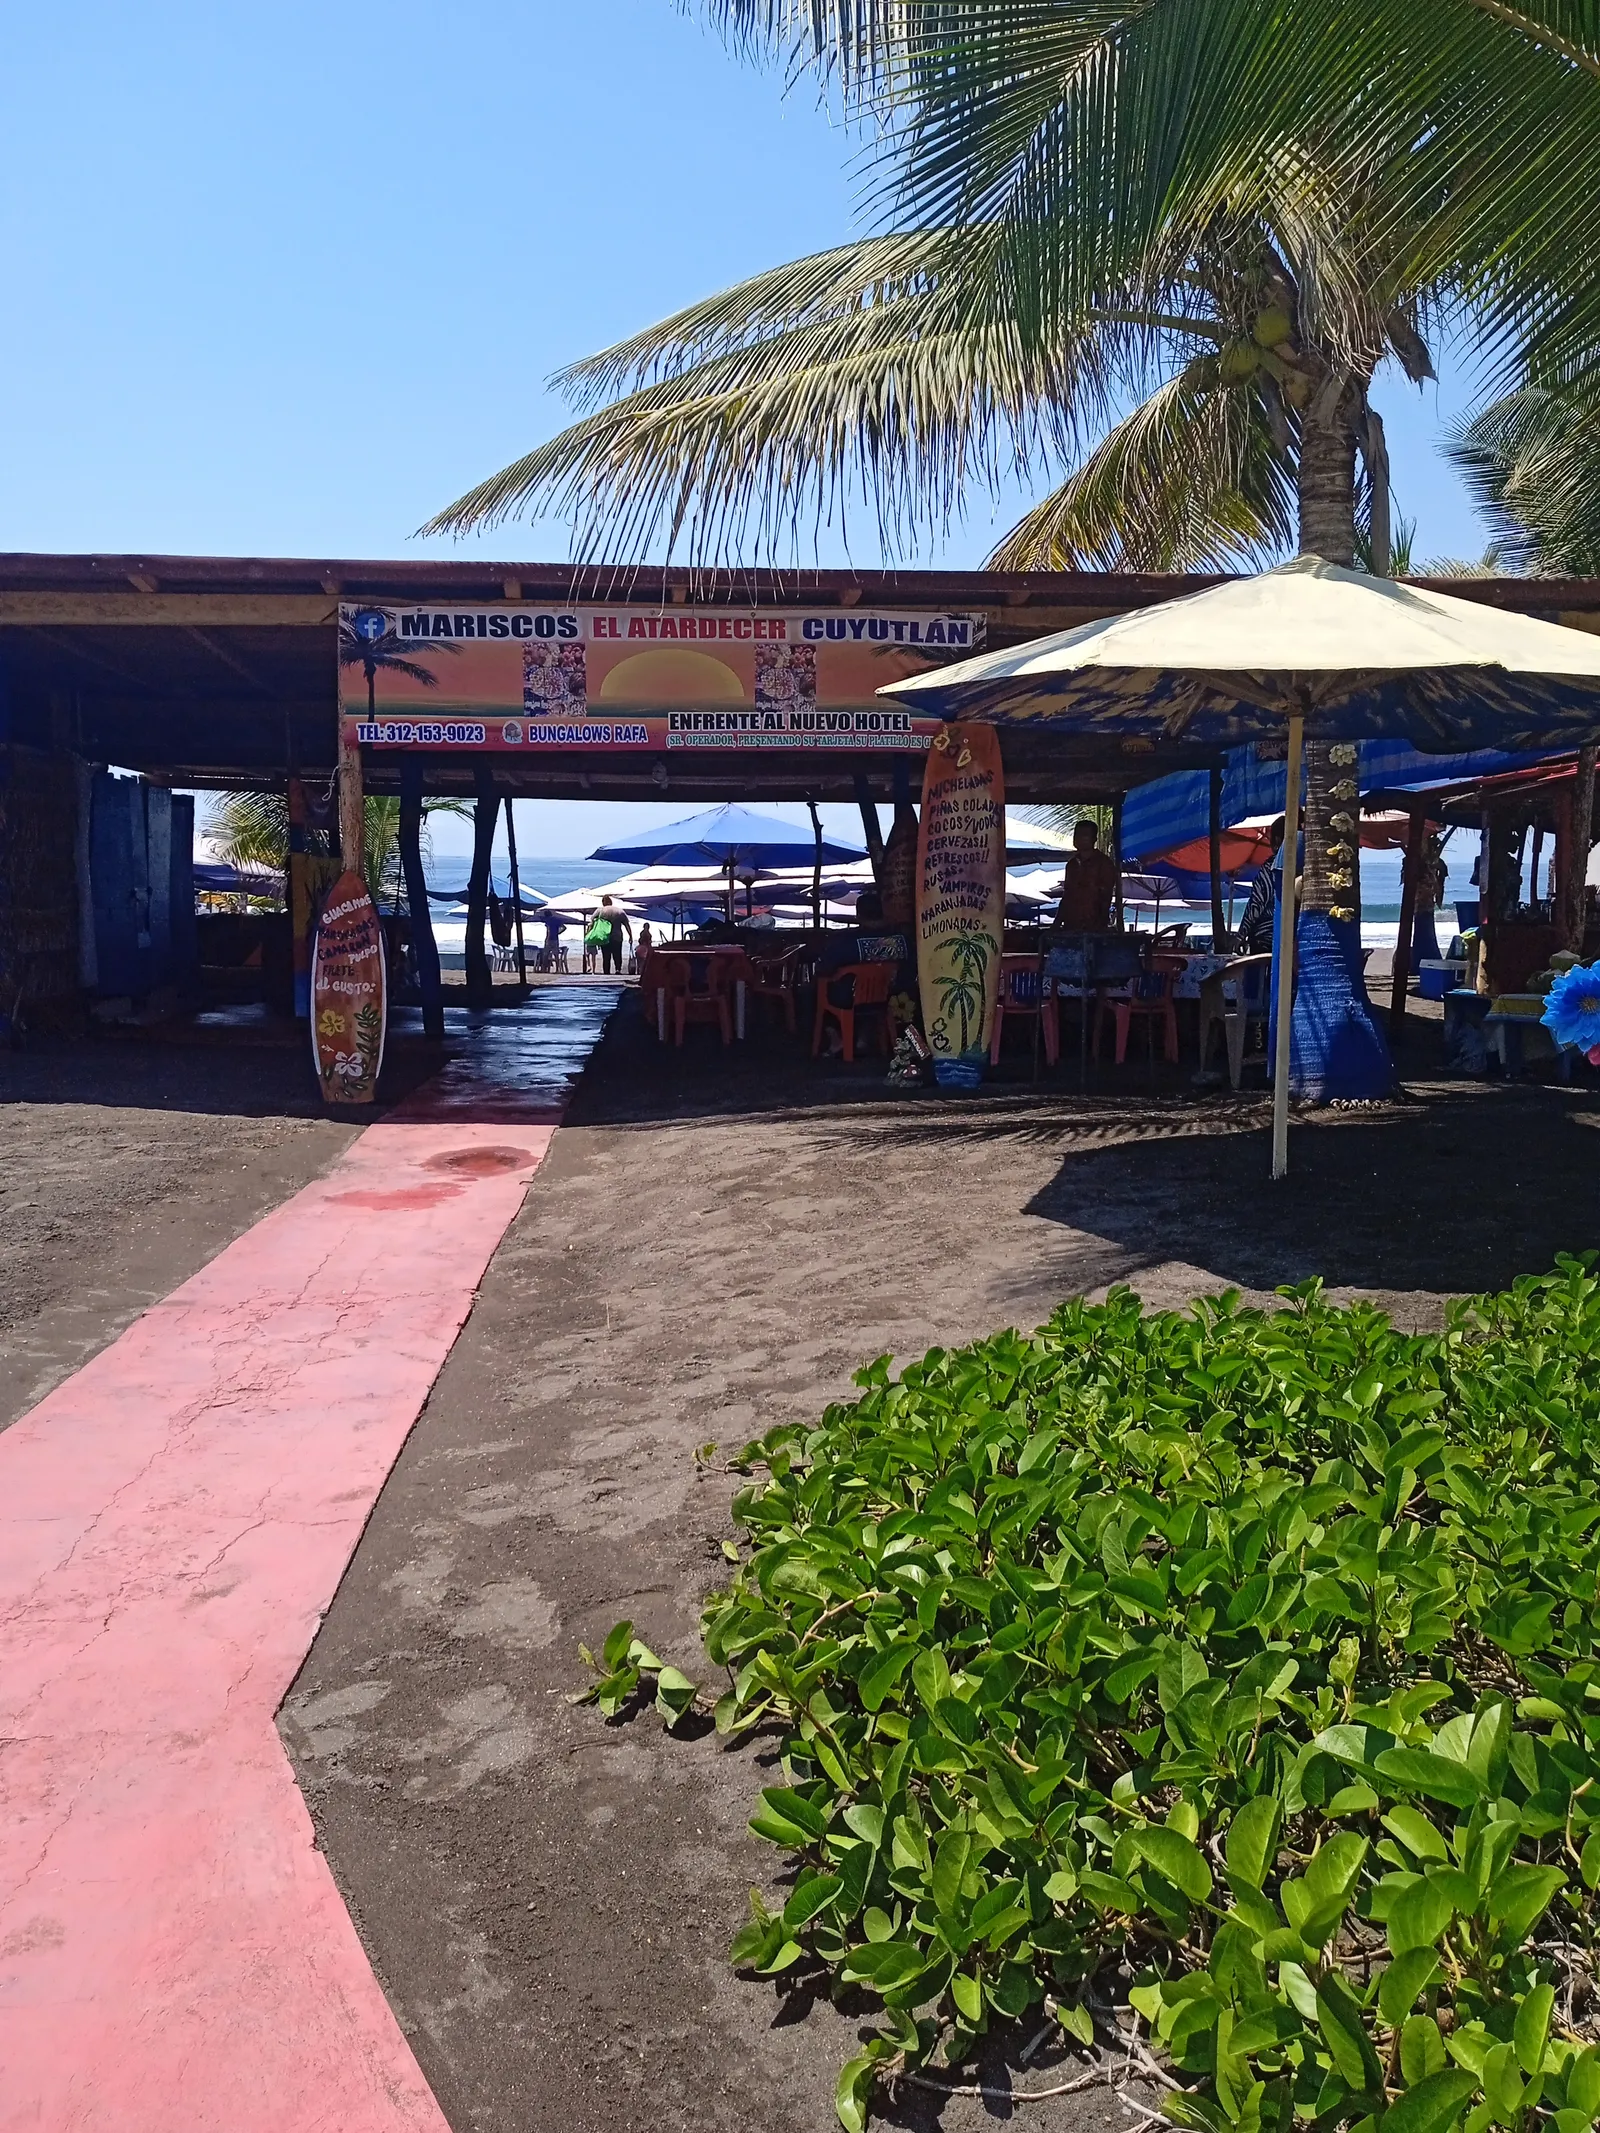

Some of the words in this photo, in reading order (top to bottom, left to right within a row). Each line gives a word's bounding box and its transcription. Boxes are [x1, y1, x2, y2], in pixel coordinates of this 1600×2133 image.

[402, 615, 578, 638] MARISCOS
[593, 617, 621, 638] EL
[629, 617, 786, 639] ATARDECER
[670, 713, 760, 730] ENFRENTE
[764, 713, 785, 730] AL
[790, 714, 850, 730] NUEVO
[855, 714, 911, 731] HOTEL
[529, 726, 610, 743] BUNGALOWS
[615, 726, 647, 742] RAFA
[666, 735, 684, 747] (SR.
[686, 735, 736, 747] OPERADOR,
[738, 735, 801, 747] PRESENTANDO
[803, 735, 815, 746] SU
[816, 735, 854, 746] TARJETA
[856, 736, 868, 747] SU
[870, 736, 909, 747] PLATILLO
[911, 737, 922, 747] ES
[924, 737, 934, 748] G
[928, 770, 994, 802] MICHELADAS
[929, 799, 960, 822] PIÑAS
[927, 816, 962, 835] COCOS
[927, 834, 988, 852] CERVEZAS!!
[925, 850, 989, 870] REFRESCOS!!
[939, 881, 992, 898] VAMPIROS
[922, 896, 986, 922] NARANJADAS
[922, 918, 980, 939] LIMONADAS
[318, 934, 371, 961] CAMARON
[348, 944, 378, 964] PULPO
[333, 981, 376, 995] GUSTO:
